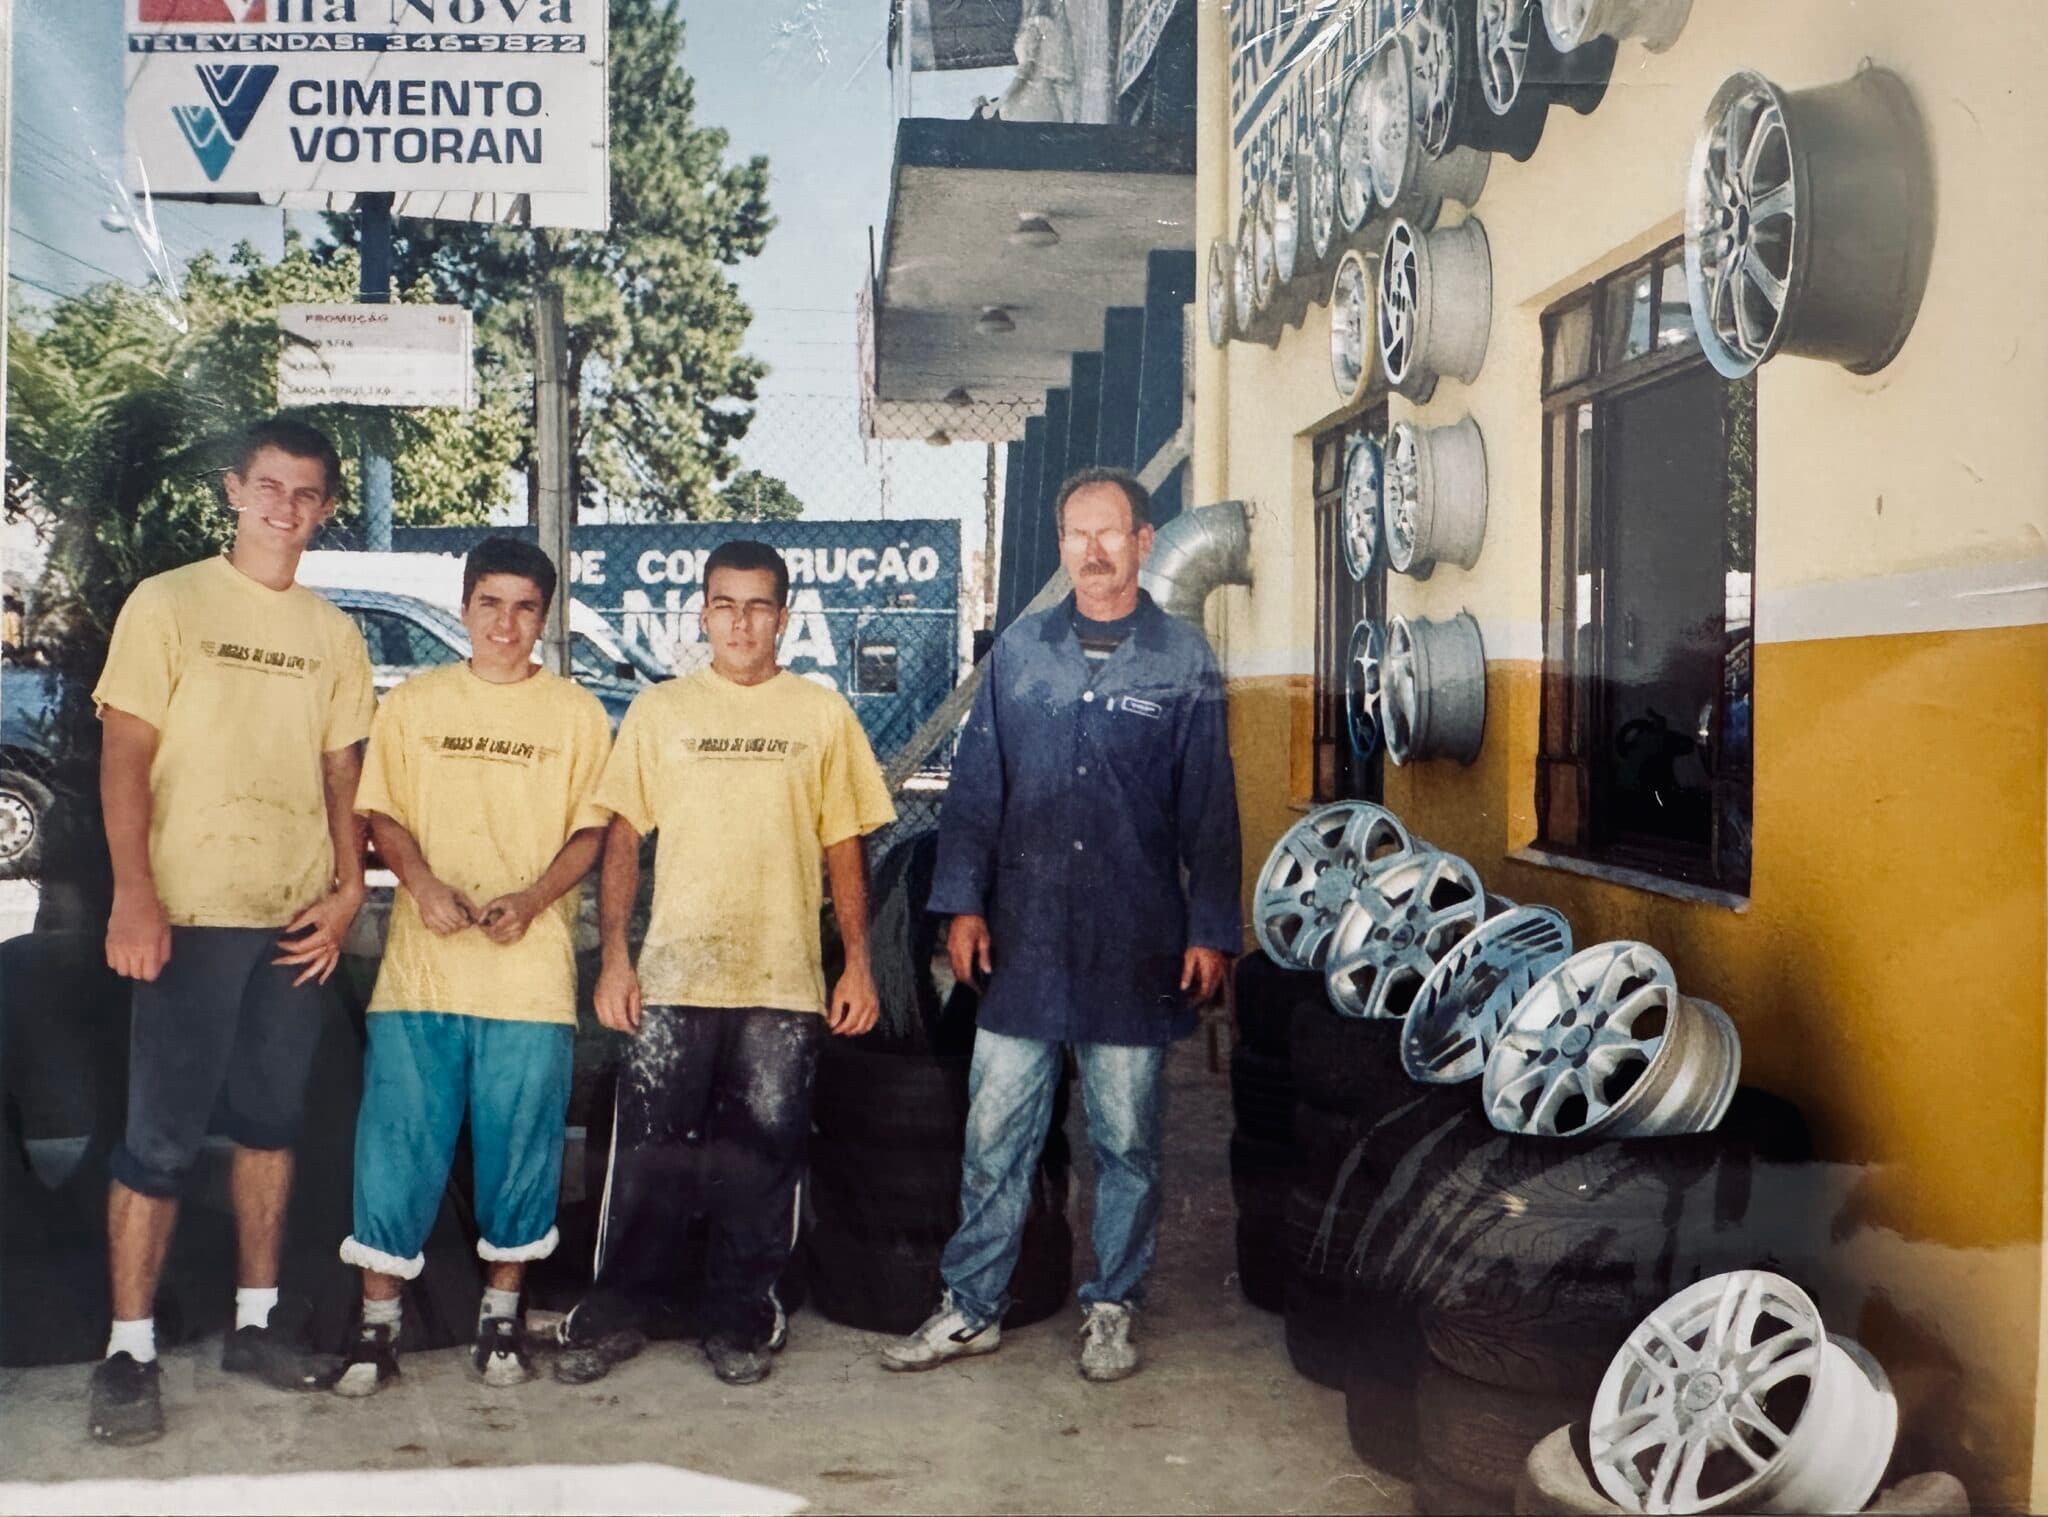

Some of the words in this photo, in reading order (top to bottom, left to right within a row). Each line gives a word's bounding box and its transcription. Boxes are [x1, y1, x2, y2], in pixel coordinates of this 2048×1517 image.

[132, 33, 366, 51] TELEVENDAS:
[386, 34, 582, 52] 346-9822
[288, 79, 543, 117] CIMENTO
[289, 126, 543, 164] VOTORAN
[636, 541, 940, 590] CORUÇÃO
[623, 588, 838, 668] NA
